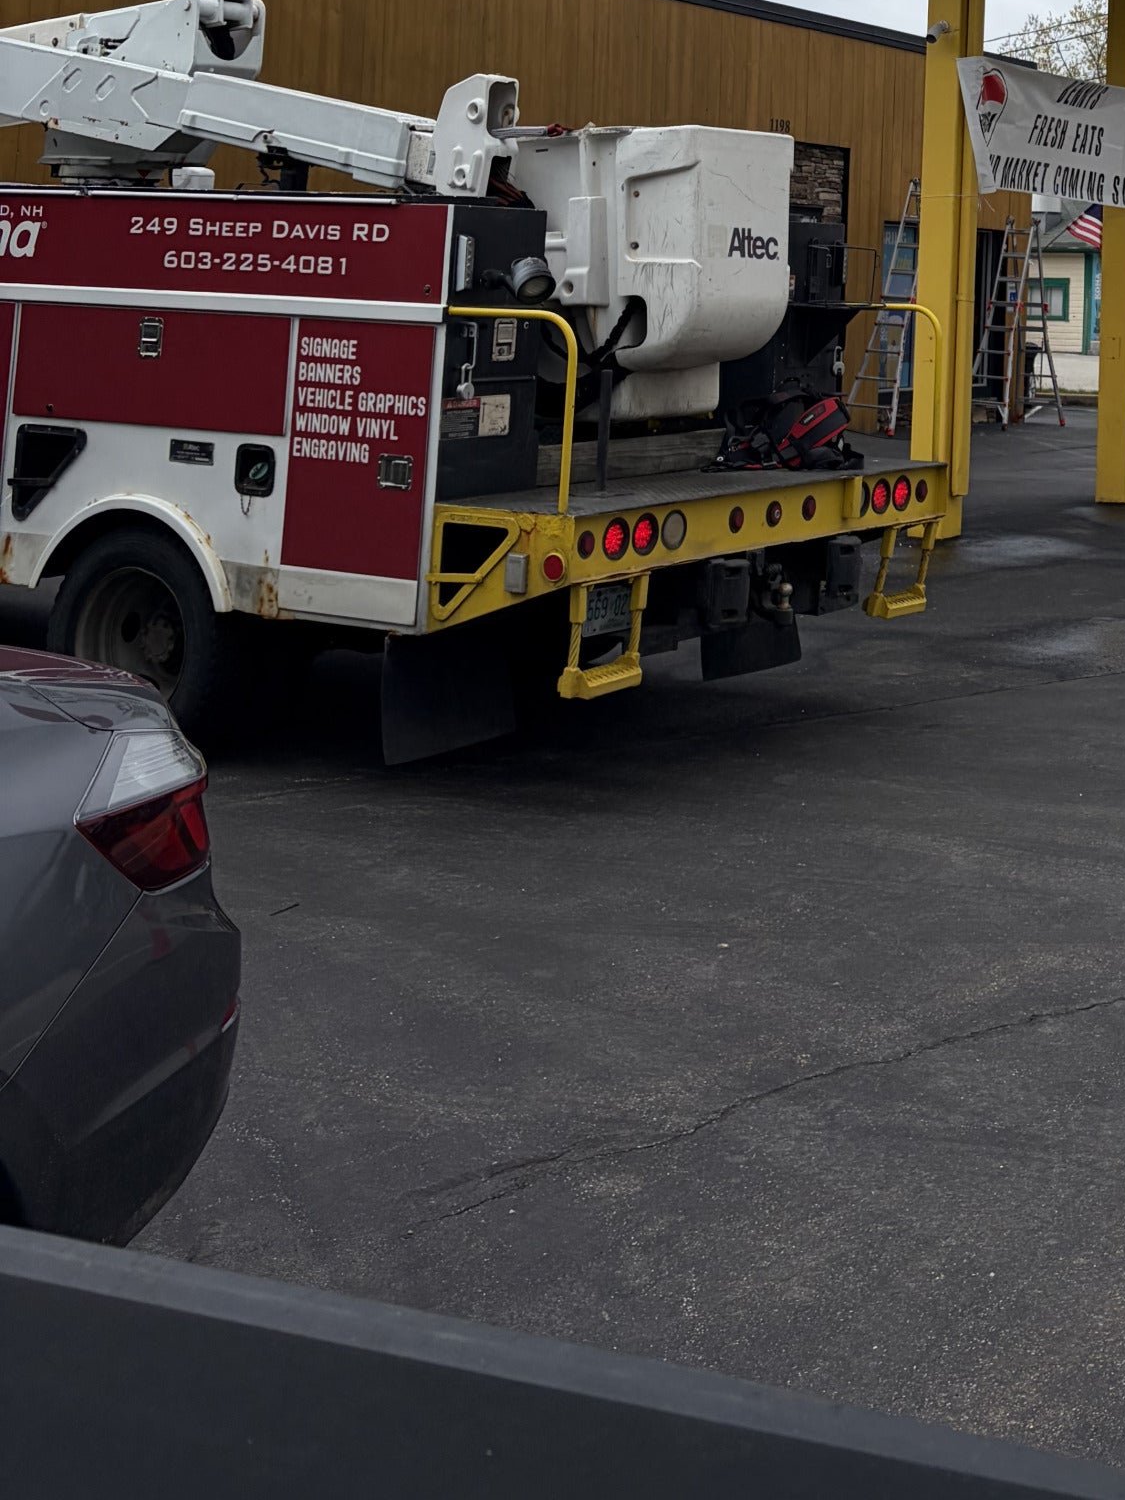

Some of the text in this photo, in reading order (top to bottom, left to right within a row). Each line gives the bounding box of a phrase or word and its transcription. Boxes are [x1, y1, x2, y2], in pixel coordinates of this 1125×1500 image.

[769, 118, 791, 133] 1198
[1027, 114, 1105, 157] FRESH EATS
[1000, 156, 1050, 193] MARKET
[1053, 165, 1105, 202] COMING
[20, 205, 43, 217] NH
[129, 217, 178, 235] 249
[352, 223, 390, 242] RD
[727, 227, 779, 260] Altec
[163, 250, 348, 275] 603-225-4081
[300, 337, 358, 360] SIGNAGE
[298, 361, 361, 385] BANNERS
[298, 386, 427, 416] VEHICLE GRAPHICS
[296, 412, 399, 441] WINDOW VINYL
[293, 437, 370, 464] ENGRAVING
